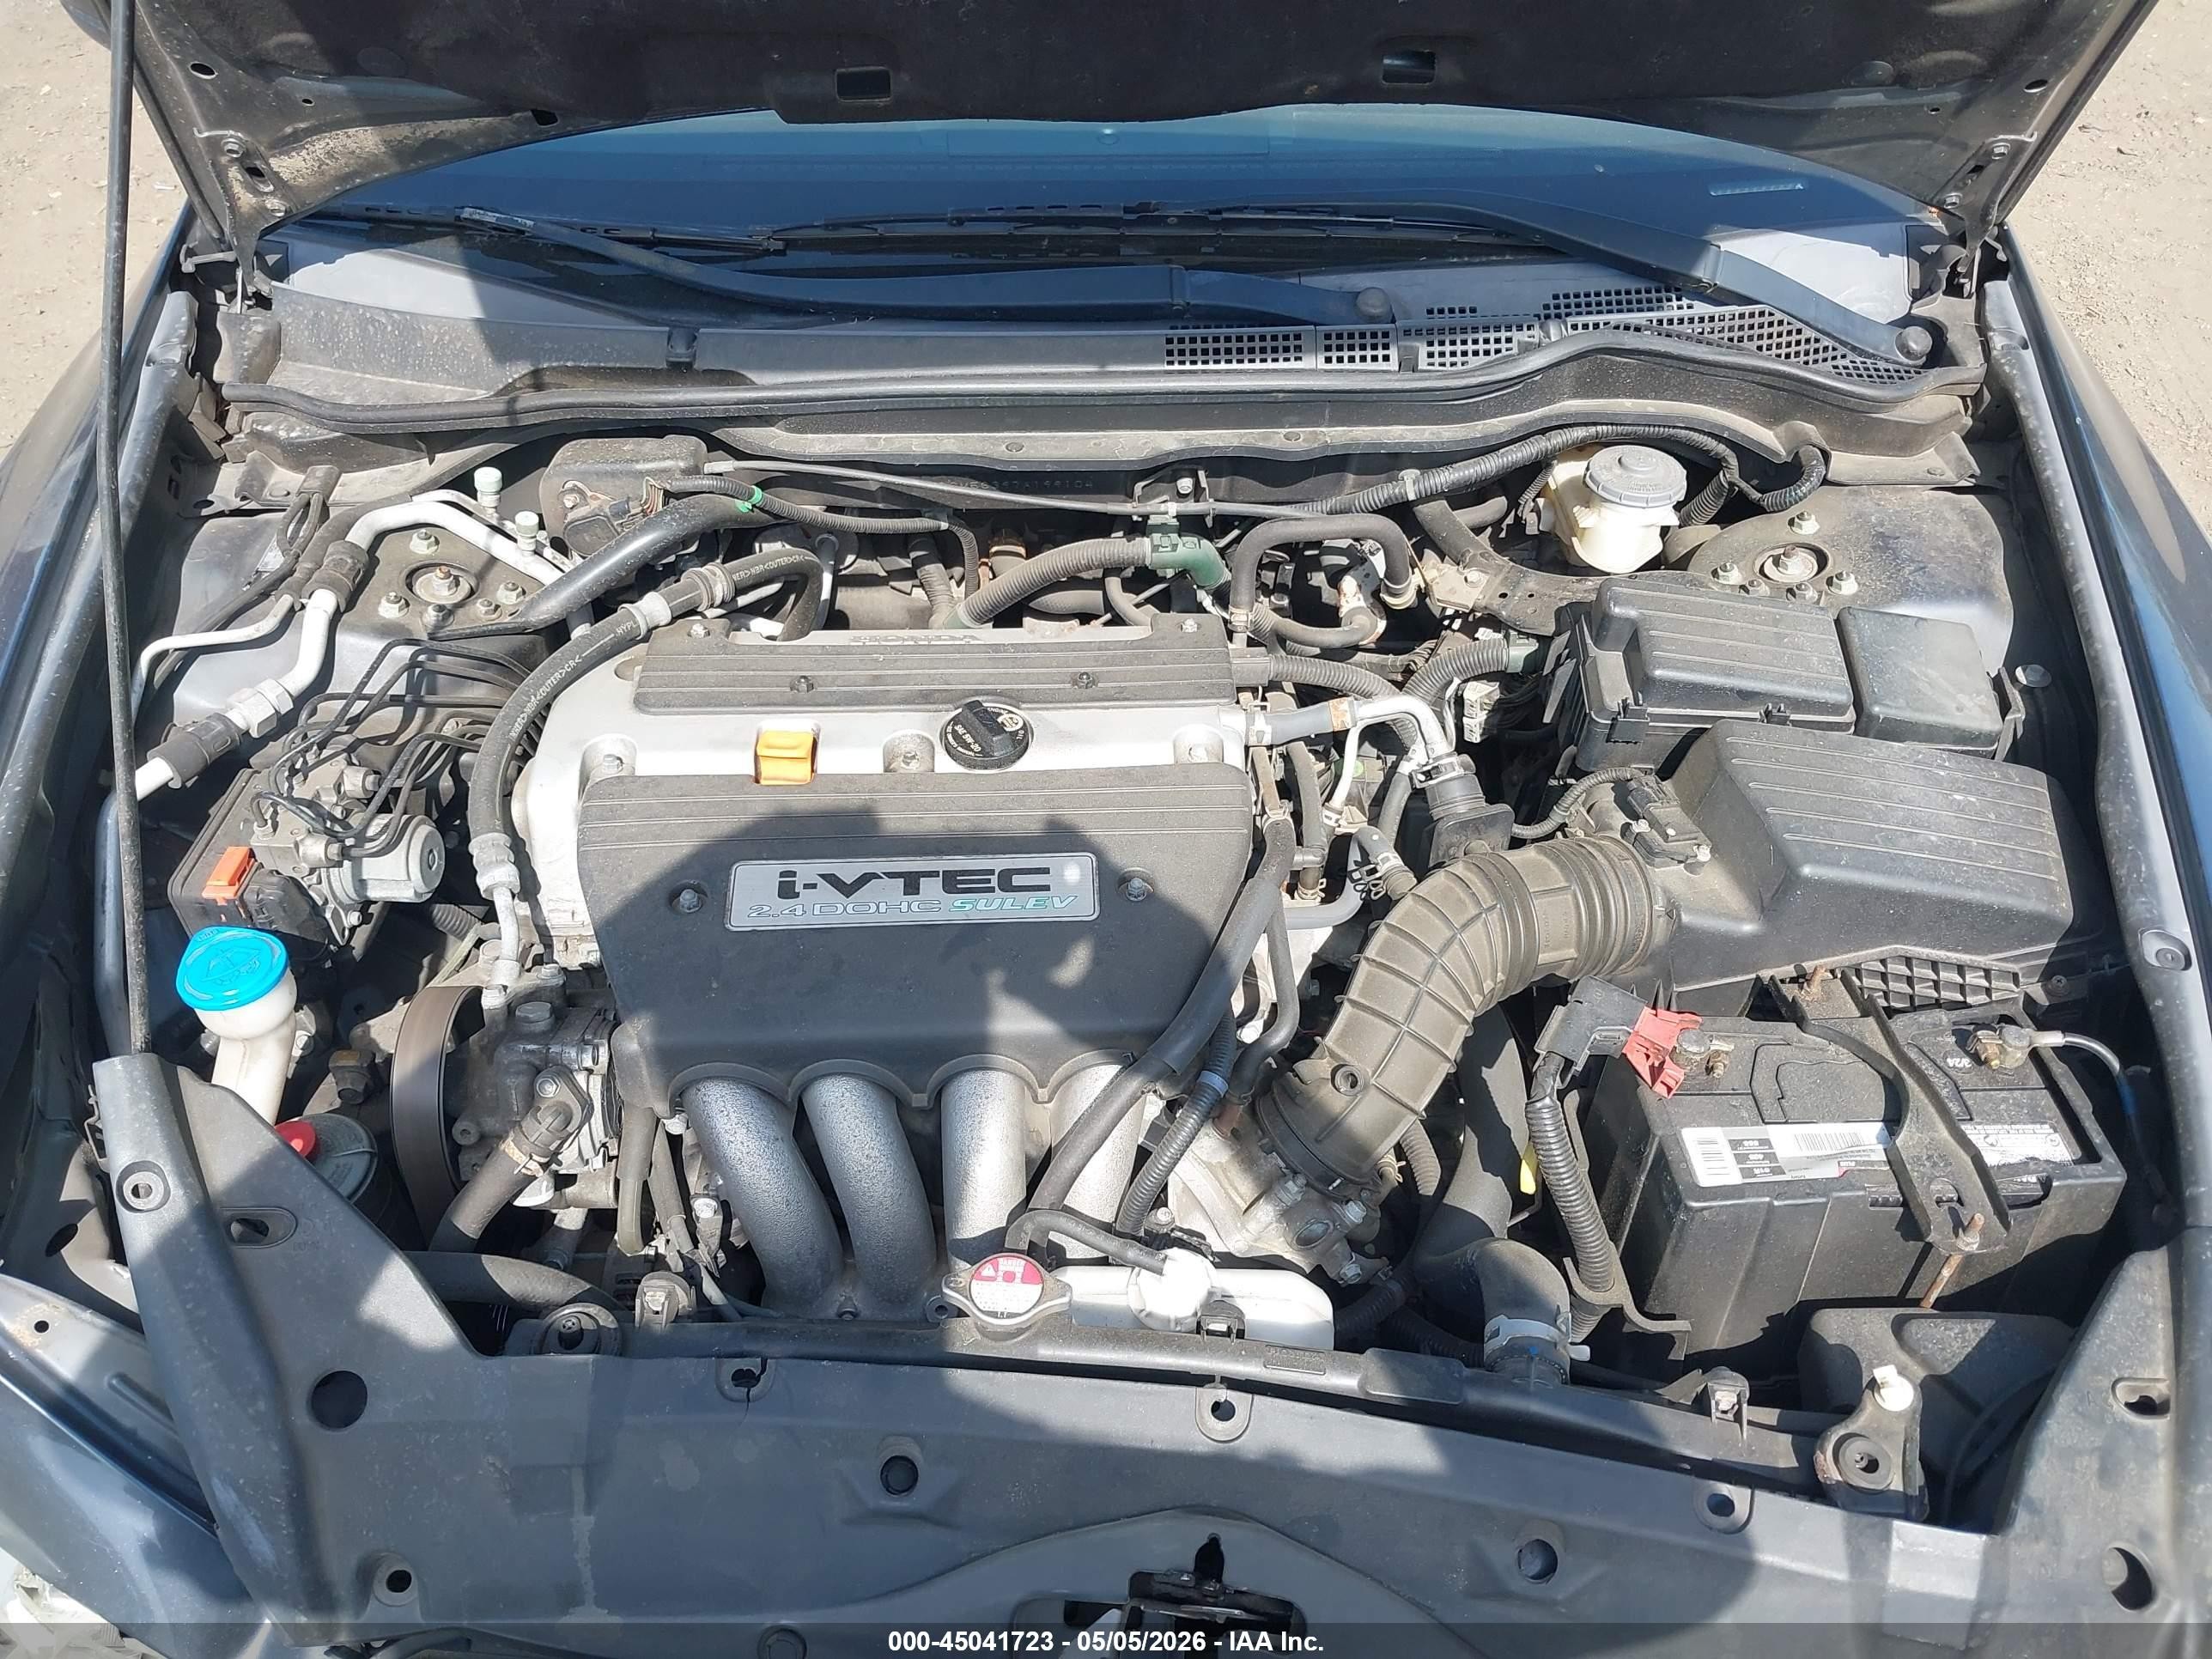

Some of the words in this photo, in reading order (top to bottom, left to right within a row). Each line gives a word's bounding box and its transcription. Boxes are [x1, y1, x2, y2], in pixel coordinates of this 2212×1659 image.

[1016, 730, 1024, 740] OIL
[777, 867, 1050, 899] i-VTEC
[948, 895, 1079, 912] SULEV
